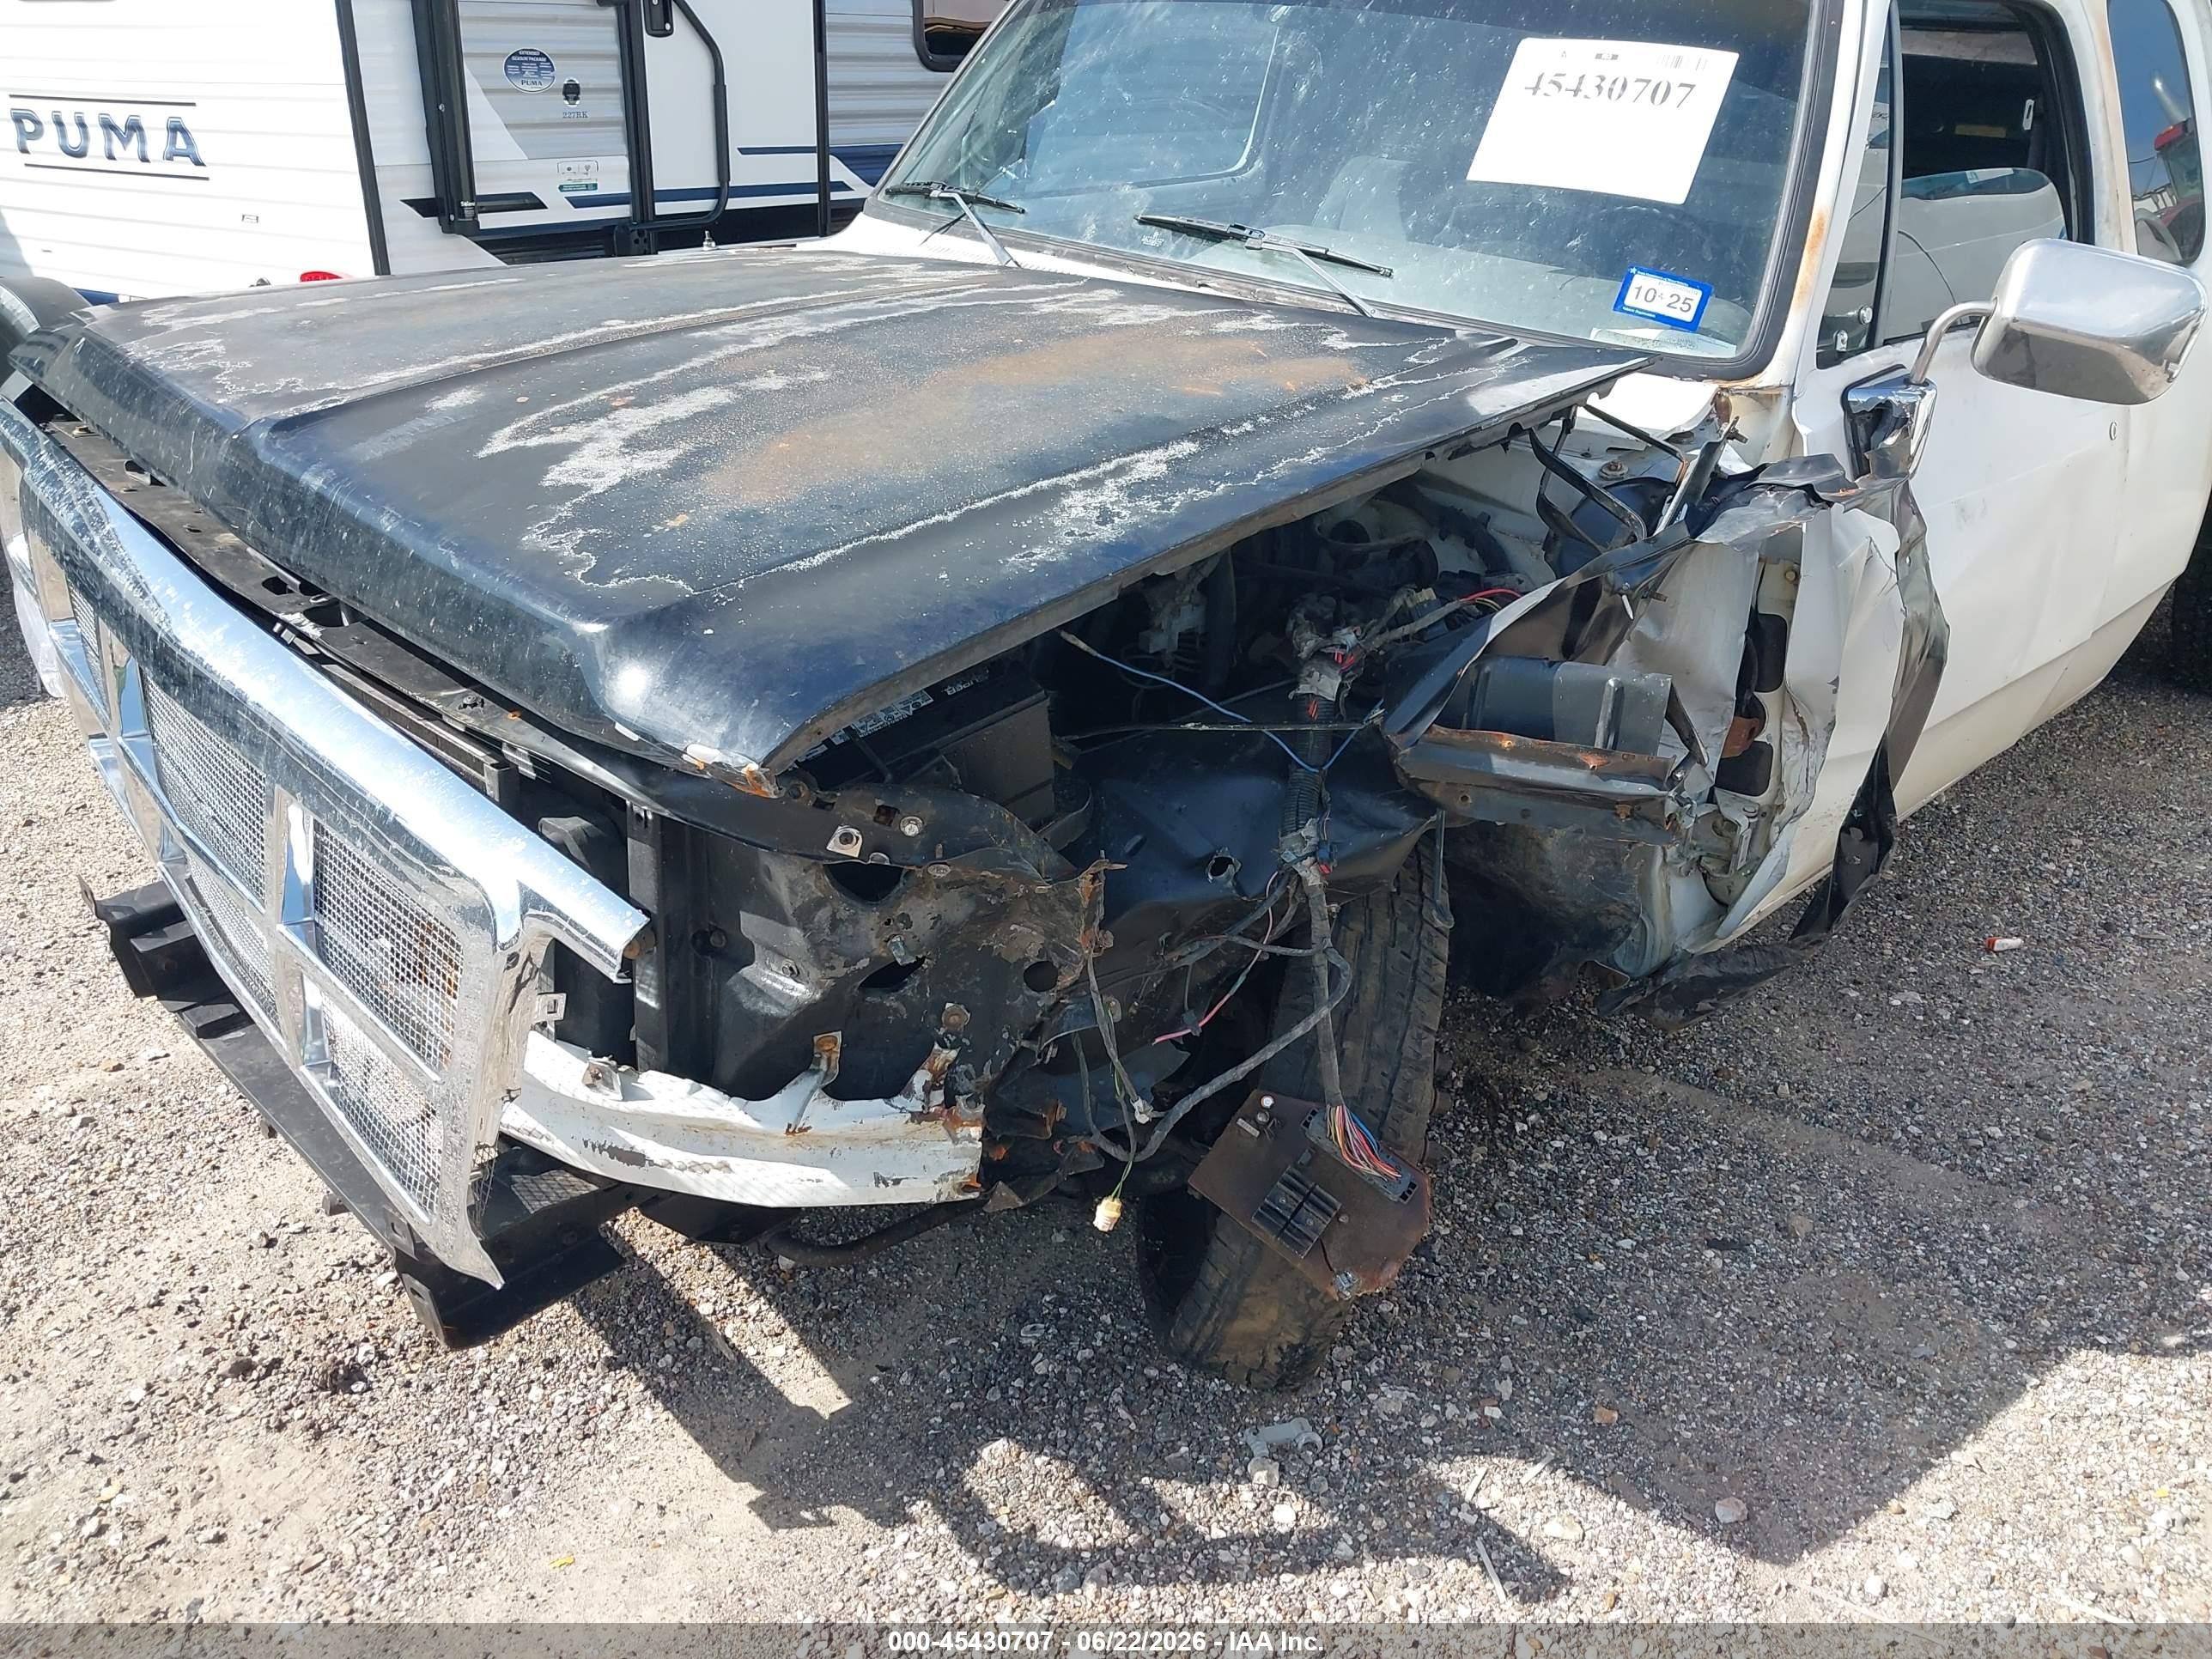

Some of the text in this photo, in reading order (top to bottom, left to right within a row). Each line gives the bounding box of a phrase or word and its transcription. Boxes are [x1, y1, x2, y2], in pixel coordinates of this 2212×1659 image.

[1524, 71, 1696, 109] 45430707
[10, 108, 207, 167] PUMA
[1634, 285, 1657, 303] 10
[1666, 293, 1694, 313] 25
